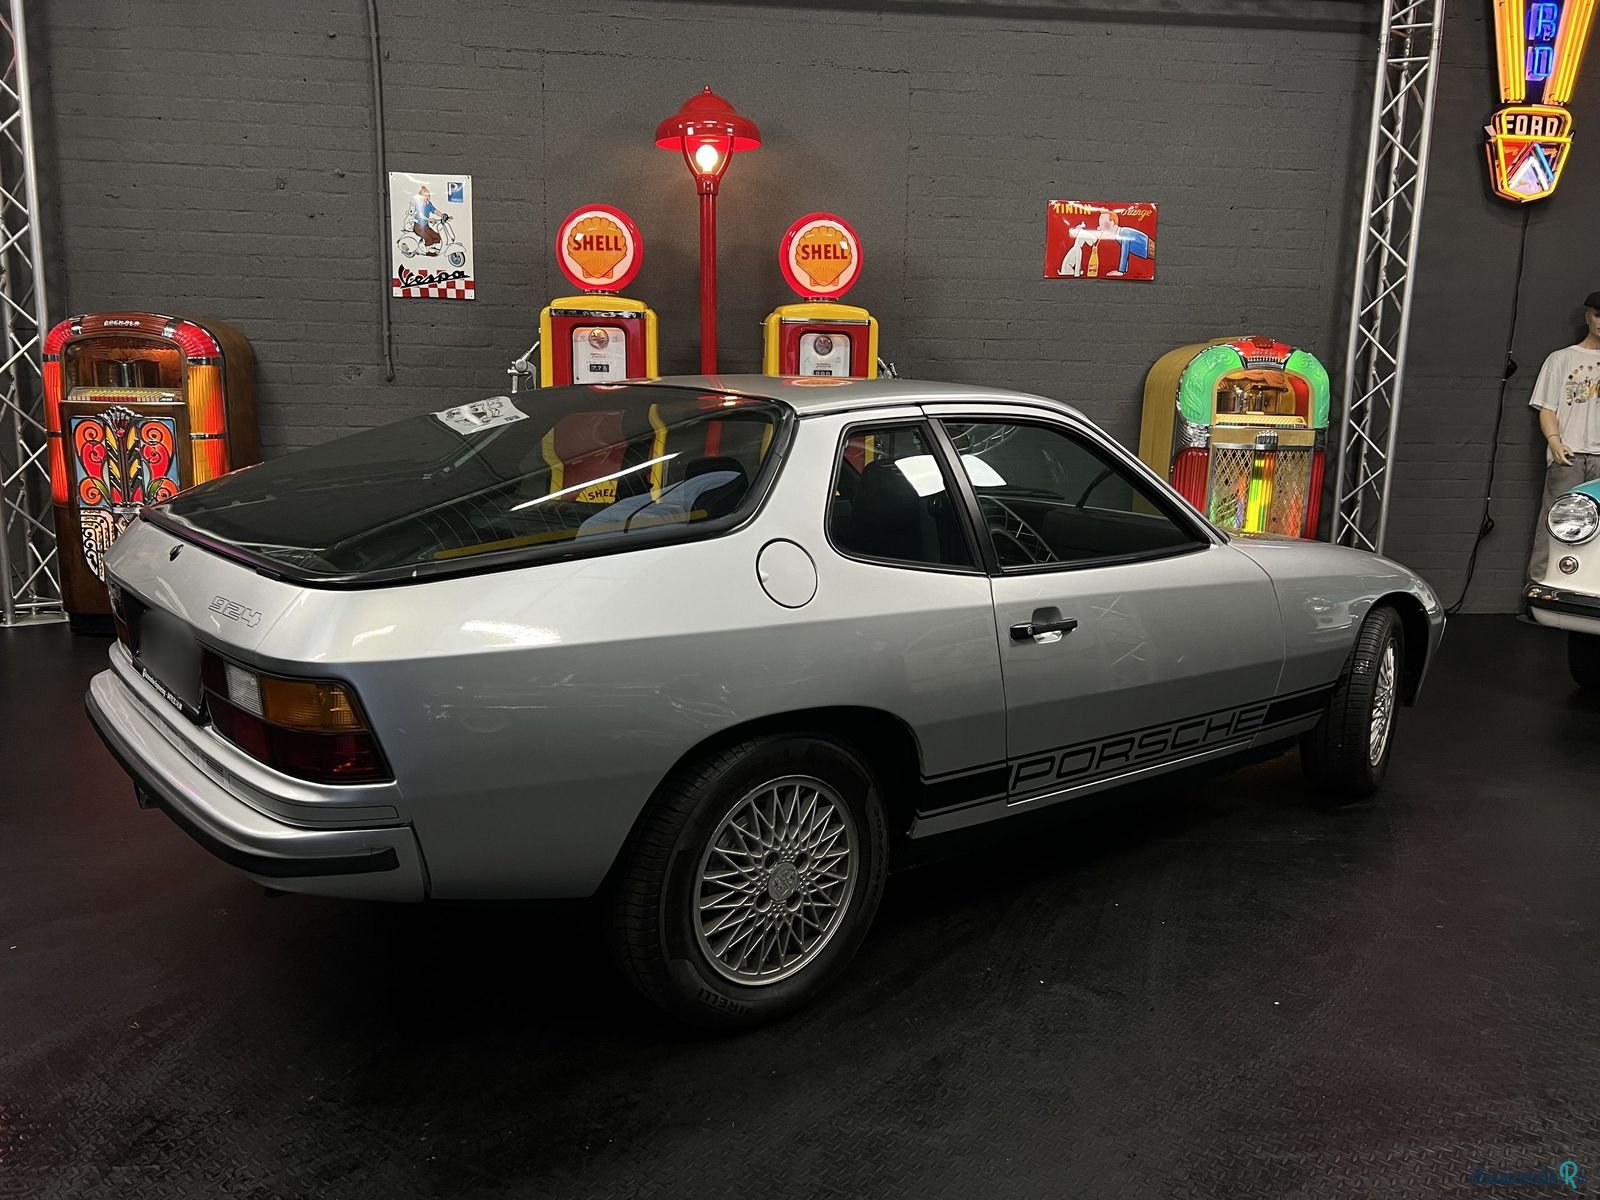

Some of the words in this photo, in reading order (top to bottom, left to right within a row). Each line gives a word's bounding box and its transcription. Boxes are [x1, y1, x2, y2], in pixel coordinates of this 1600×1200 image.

[1503, 115, 1559, 137] FORD
[1055, 203, 1092, 215] TINTIN
[573, 235, 622, 251] SHELL
[801, 244, 848, 261] SHELL
[398, 264, 470, 289] Vespa
[588, 489, 615, 500] SHEL
[208, 595, 262, 628] 924
[1010, 703, 1270, 790] PORSCHE
